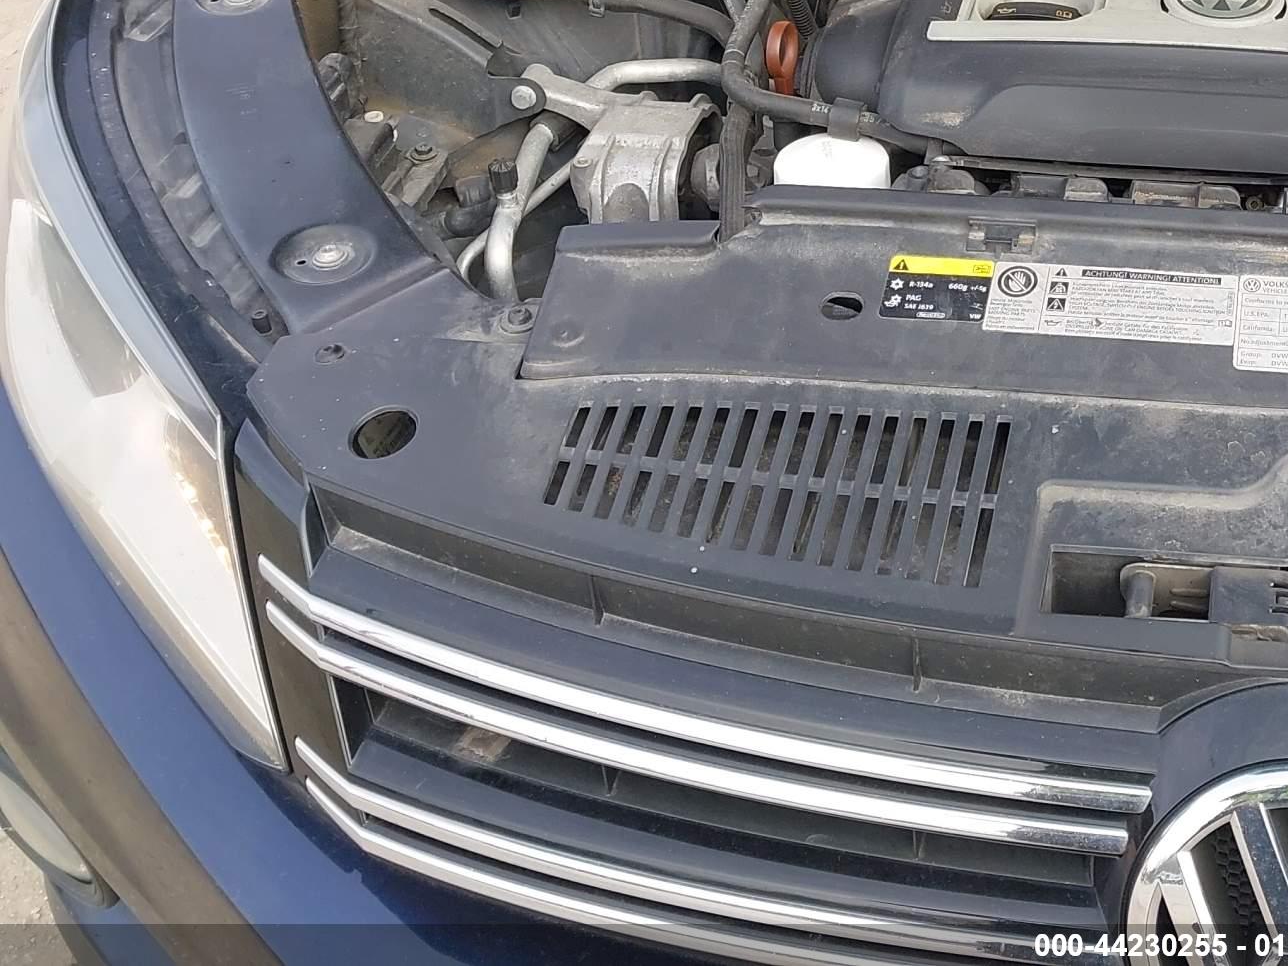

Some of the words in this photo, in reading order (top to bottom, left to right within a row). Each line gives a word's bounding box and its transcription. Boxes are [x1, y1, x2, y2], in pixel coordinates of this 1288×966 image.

[1085, 270, 1127, 278] ACHTUNG!
[1129, 273, 1171, 282] WARNING!
[1172, 276, 1219, 284] ATTENTION!
[948, 284, 968, 292] 660g
